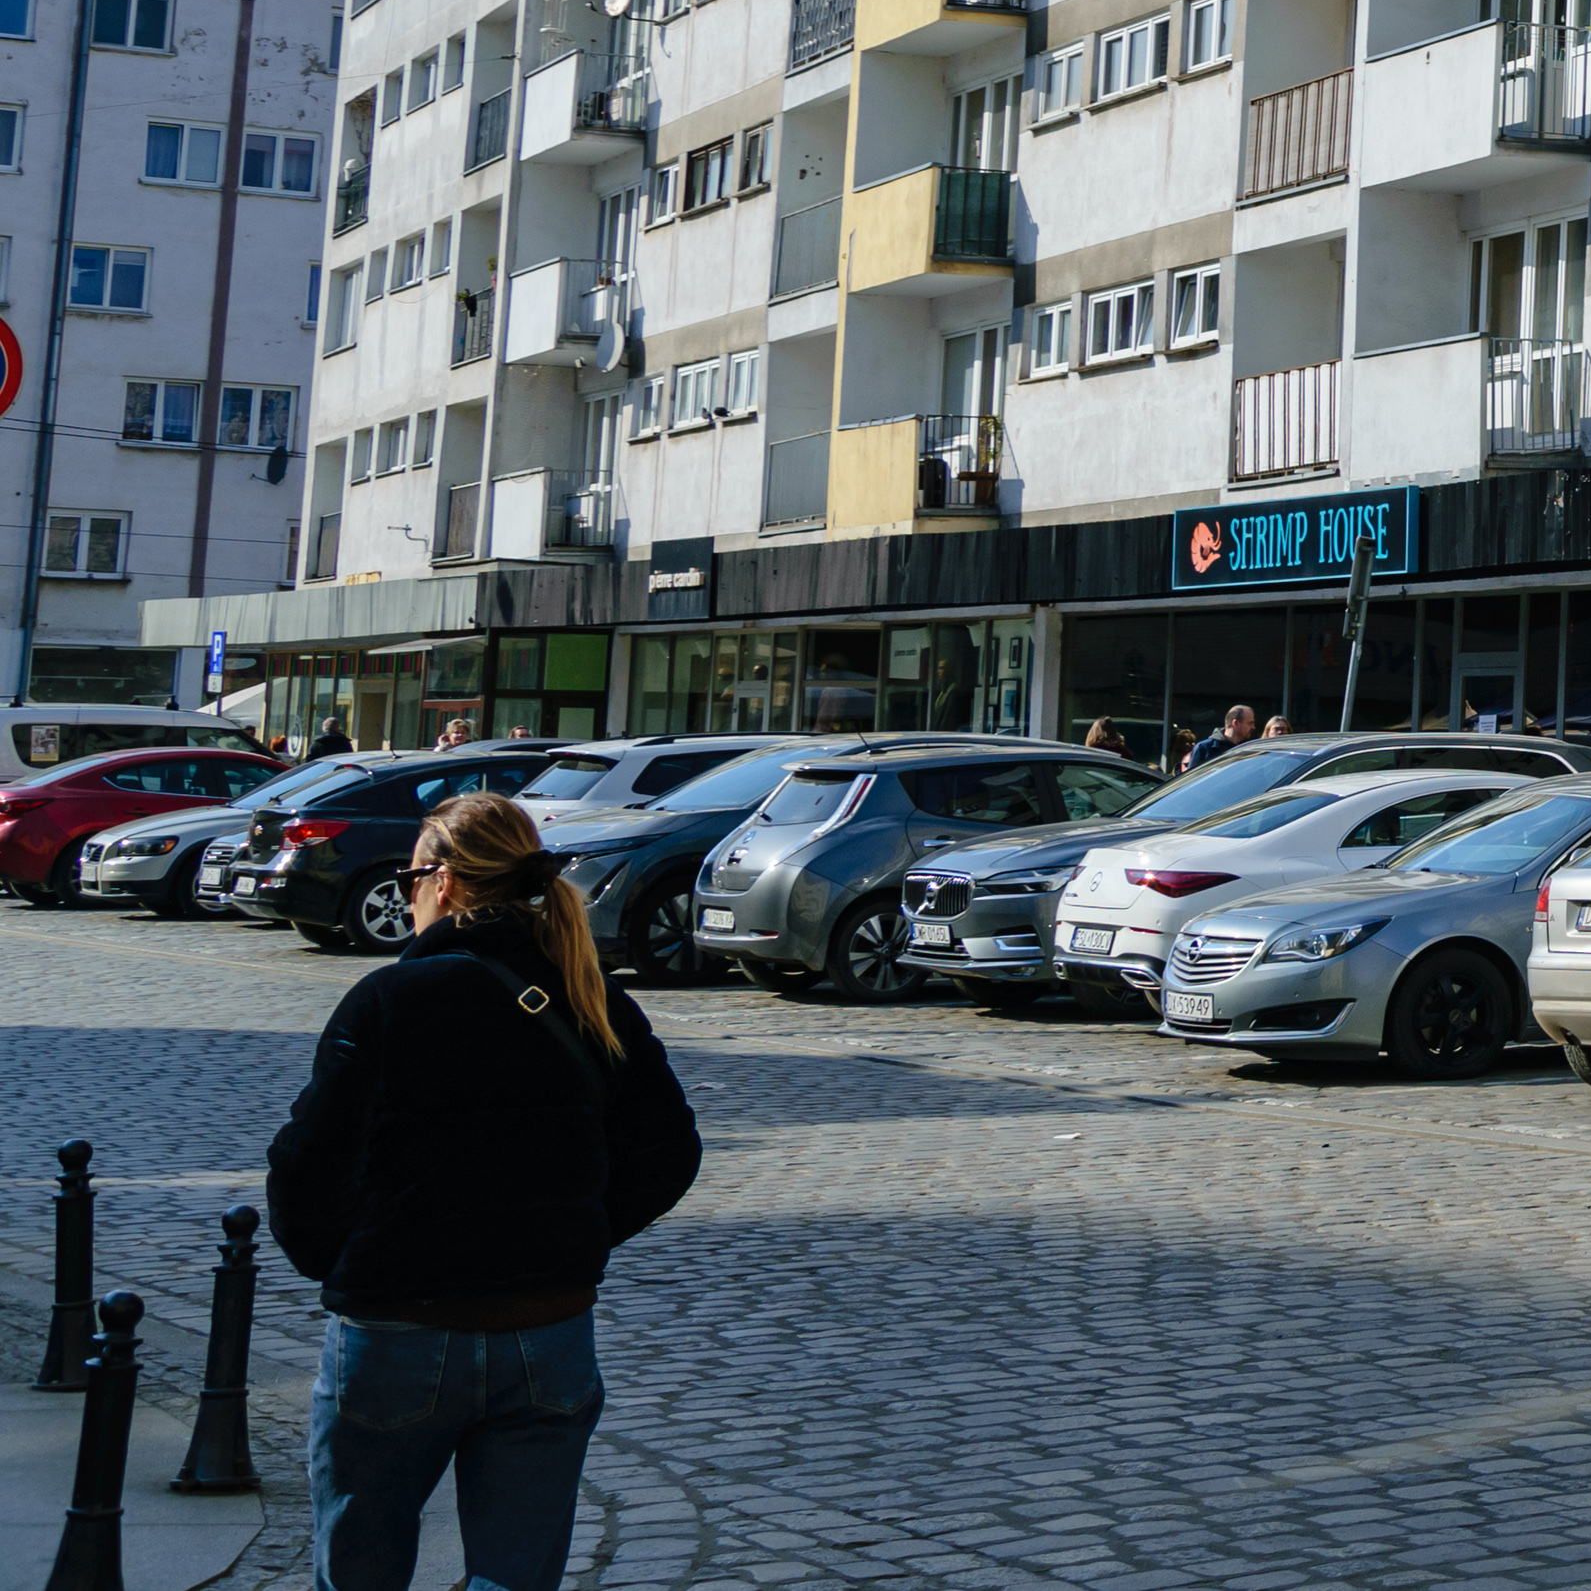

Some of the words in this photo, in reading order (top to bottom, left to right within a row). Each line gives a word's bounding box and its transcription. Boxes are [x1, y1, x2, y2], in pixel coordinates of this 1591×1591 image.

[1229, 510, 1308, 571] SHRIMP
[1317, 503, 1390, 564] HOUSE
[648, 570, 673, 593] pierre
[673, 567, 703, 587] cardin
[1179, 996, 1210, 1016] 53949
